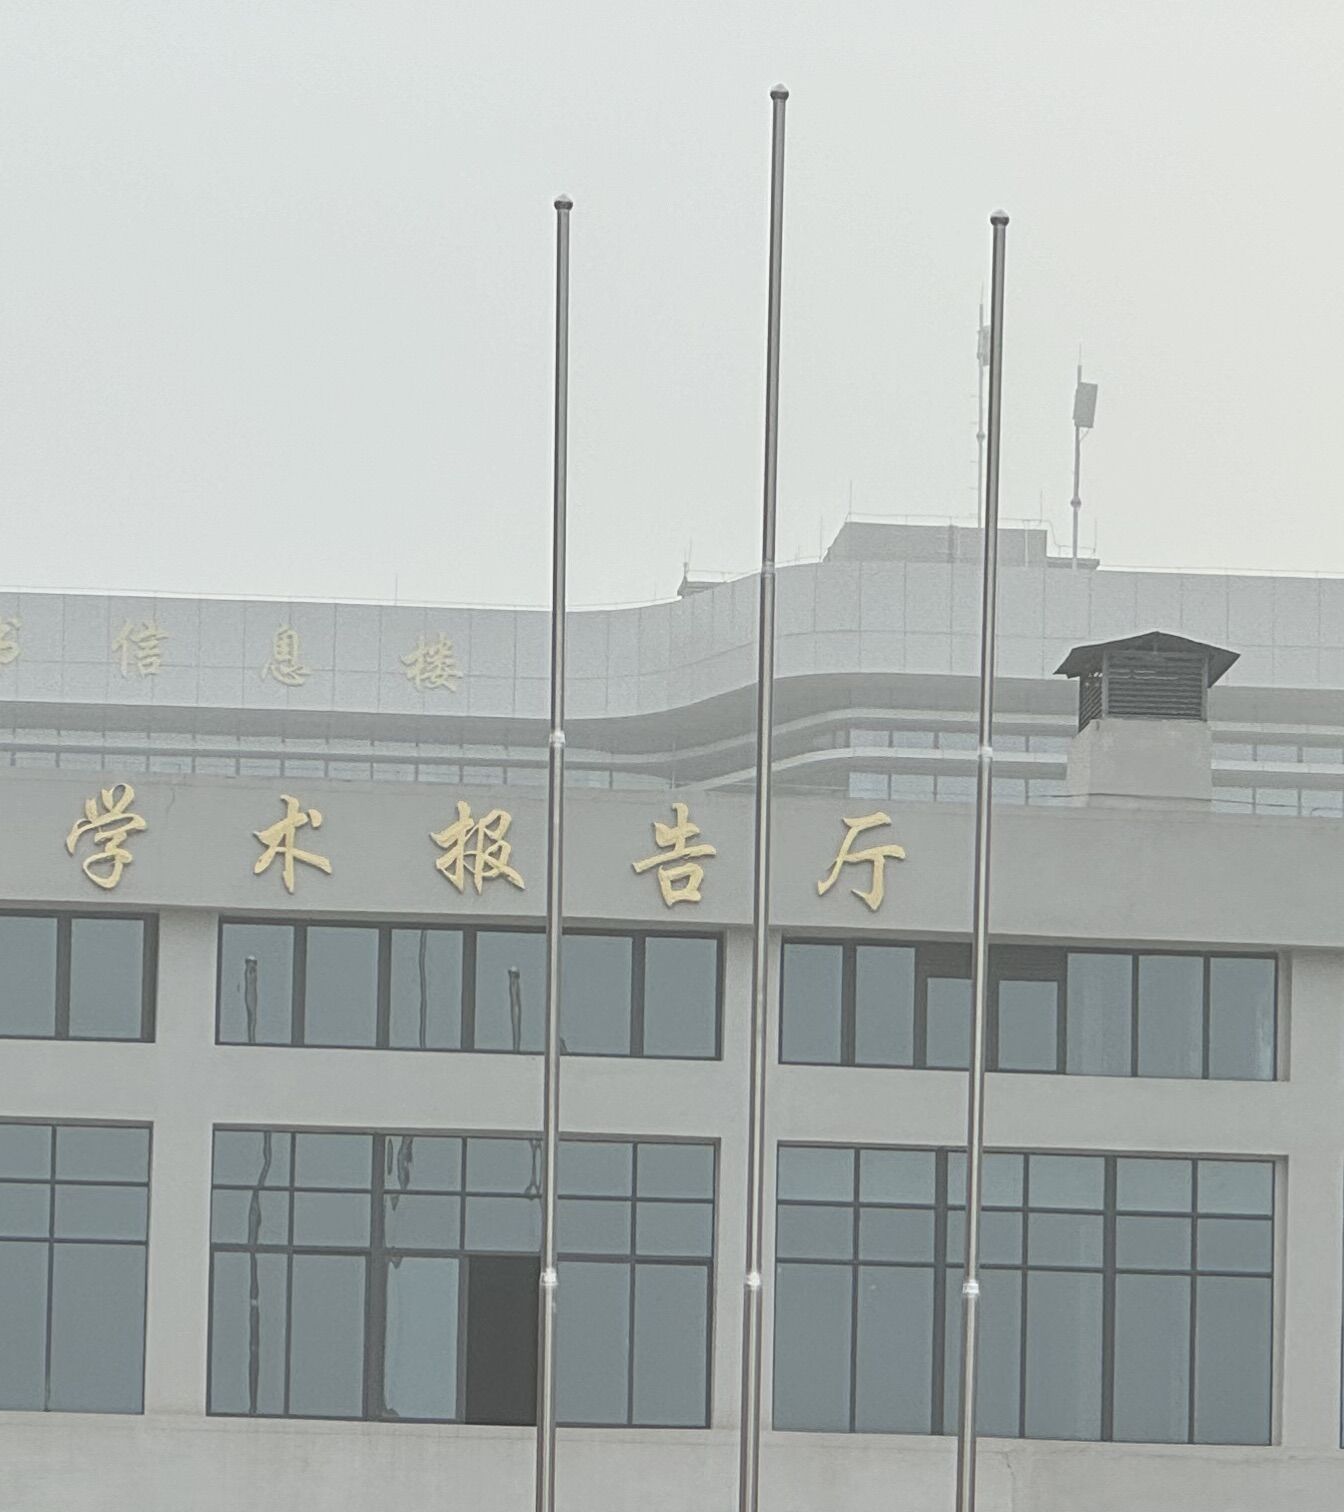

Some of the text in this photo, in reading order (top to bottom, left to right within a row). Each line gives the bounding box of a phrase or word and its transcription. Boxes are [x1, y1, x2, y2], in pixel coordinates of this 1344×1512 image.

[66, 782, 907, 911] 学术报告厅
